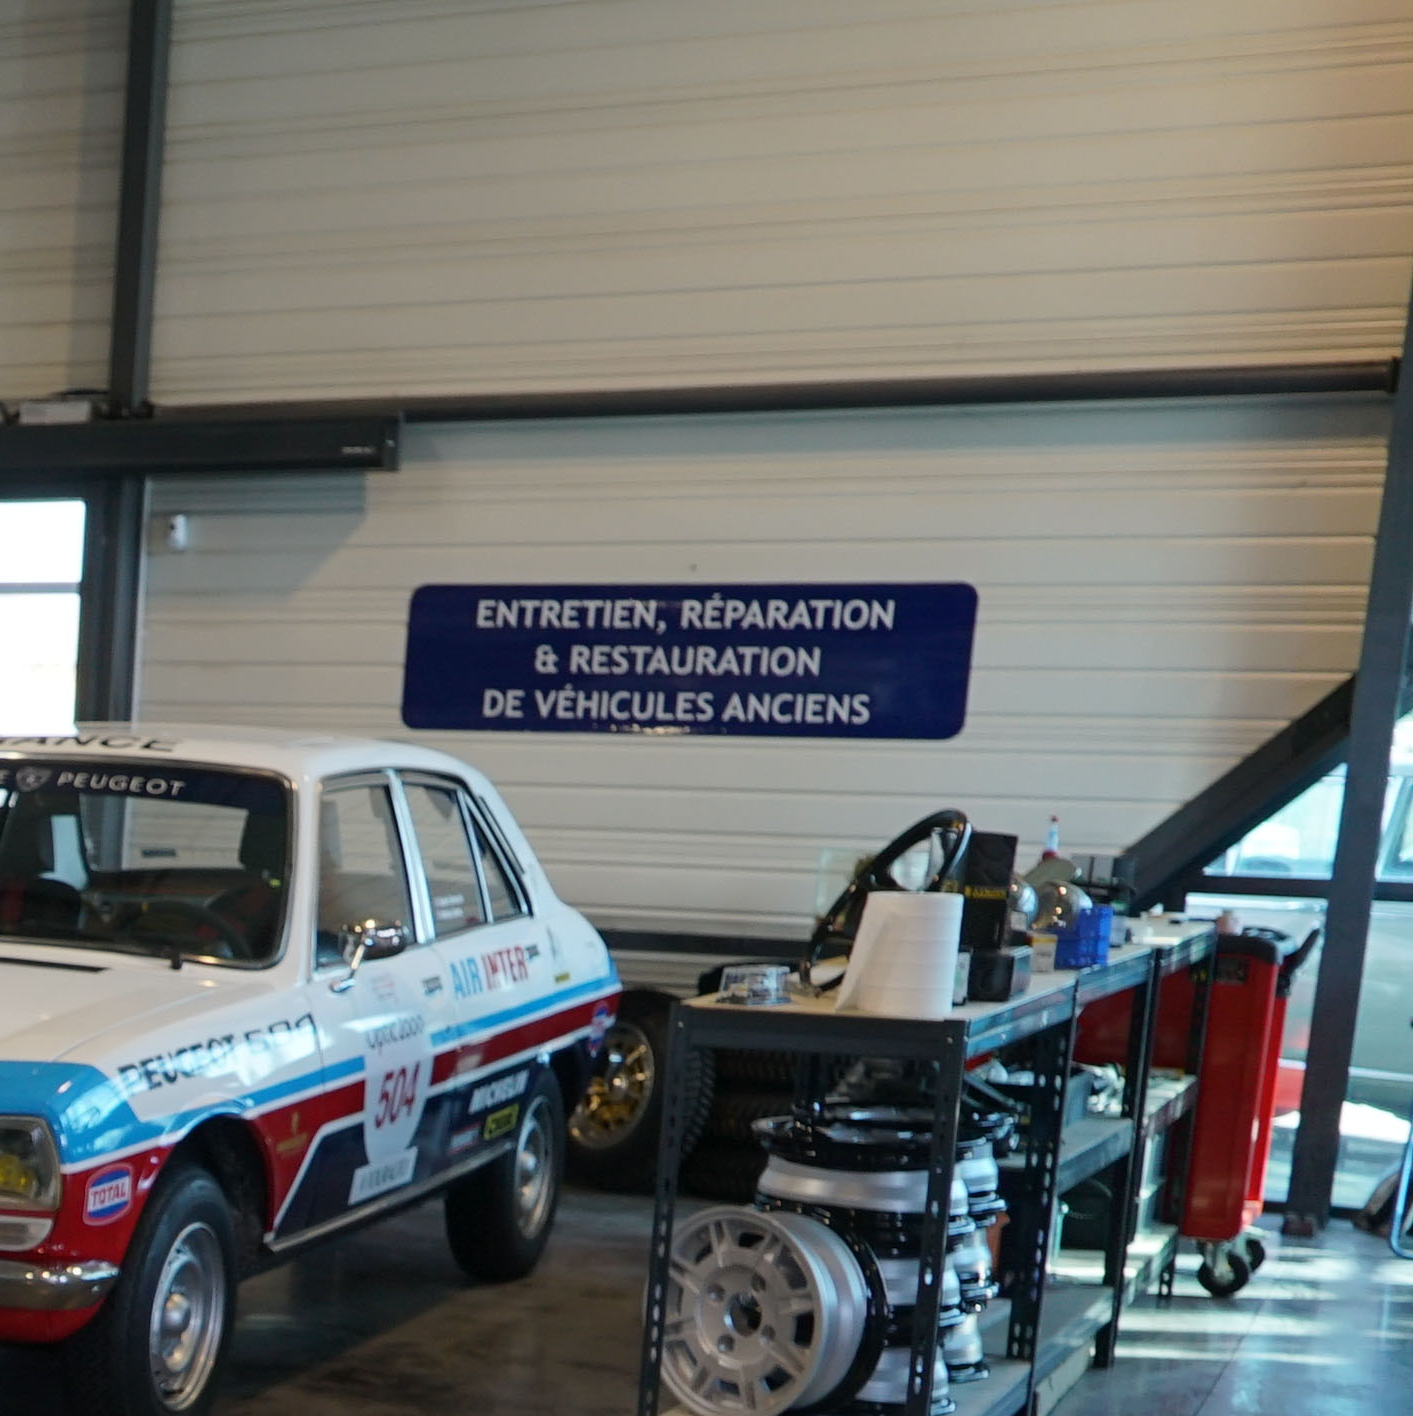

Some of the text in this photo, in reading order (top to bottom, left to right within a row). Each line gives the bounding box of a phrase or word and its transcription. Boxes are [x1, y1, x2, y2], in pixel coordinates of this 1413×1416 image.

[476, 592, 896, 634] ENTRETIEN, RÉPARATION
[534, 645, 821, 677] & RESTAURATION
[482, 684, 871, 725] DE VÉHICULES ANCIENS
[56, 770, 187, 797] PEUGEOT
[449, 957, 484, 1001] AIR
[374, 1061, 421, 1129] 504
[90, 1183, 127, 1209] TOTAL
